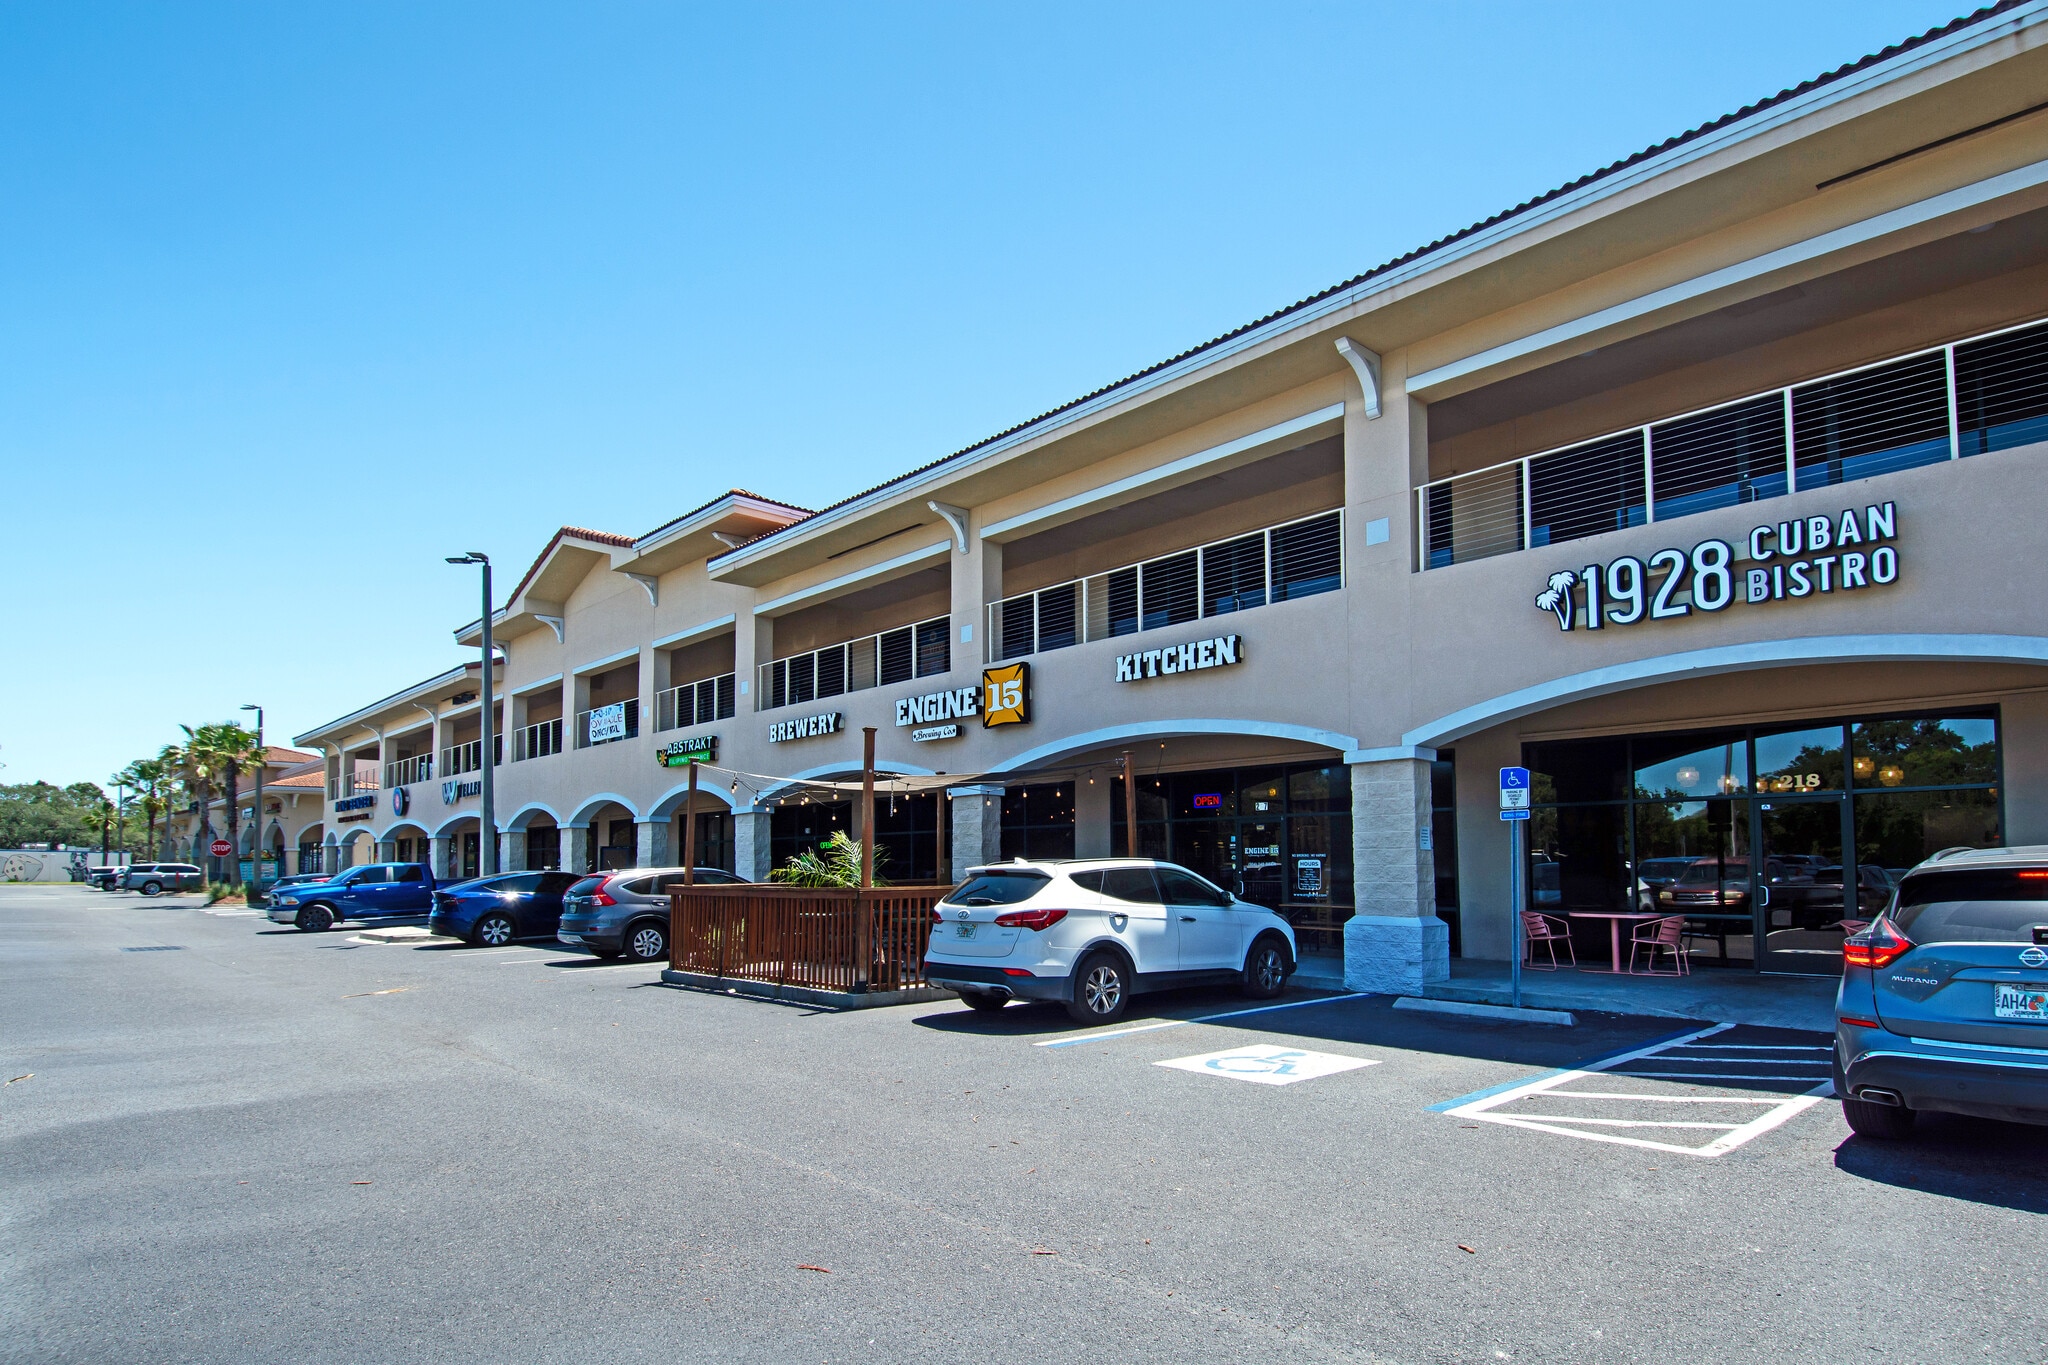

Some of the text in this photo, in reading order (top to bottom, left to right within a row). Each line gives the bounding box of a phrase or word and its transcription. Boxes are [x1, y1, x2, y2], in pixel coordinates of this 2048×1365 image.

[1750, 501, 1897, 561] CUBAN
[1748, 546, 1898, 604] BISTRO
[1583, 540, 1733, 632] 1928
[1116, 635, 1236, 682] KITCHEN
[895, 679, 1023, 726] ENGINE 15
[769, 712, 837, 743] BREWERY
[916, 730, 941, 740] Brewing
[667, 736, 713, 755] ABSTRAKT
[1780, 774, 1820, 789] 218
[1195, 796, 1219, 806] OPEN
[212, 844, 232, 852] STOP
[819, 841, 833, 849] OPEN
[1244, 847, 1269, 855] ENGINE
[1891, 976, 1938, 985] MURANO
[2001, 994, 2027, 1010] AH4
